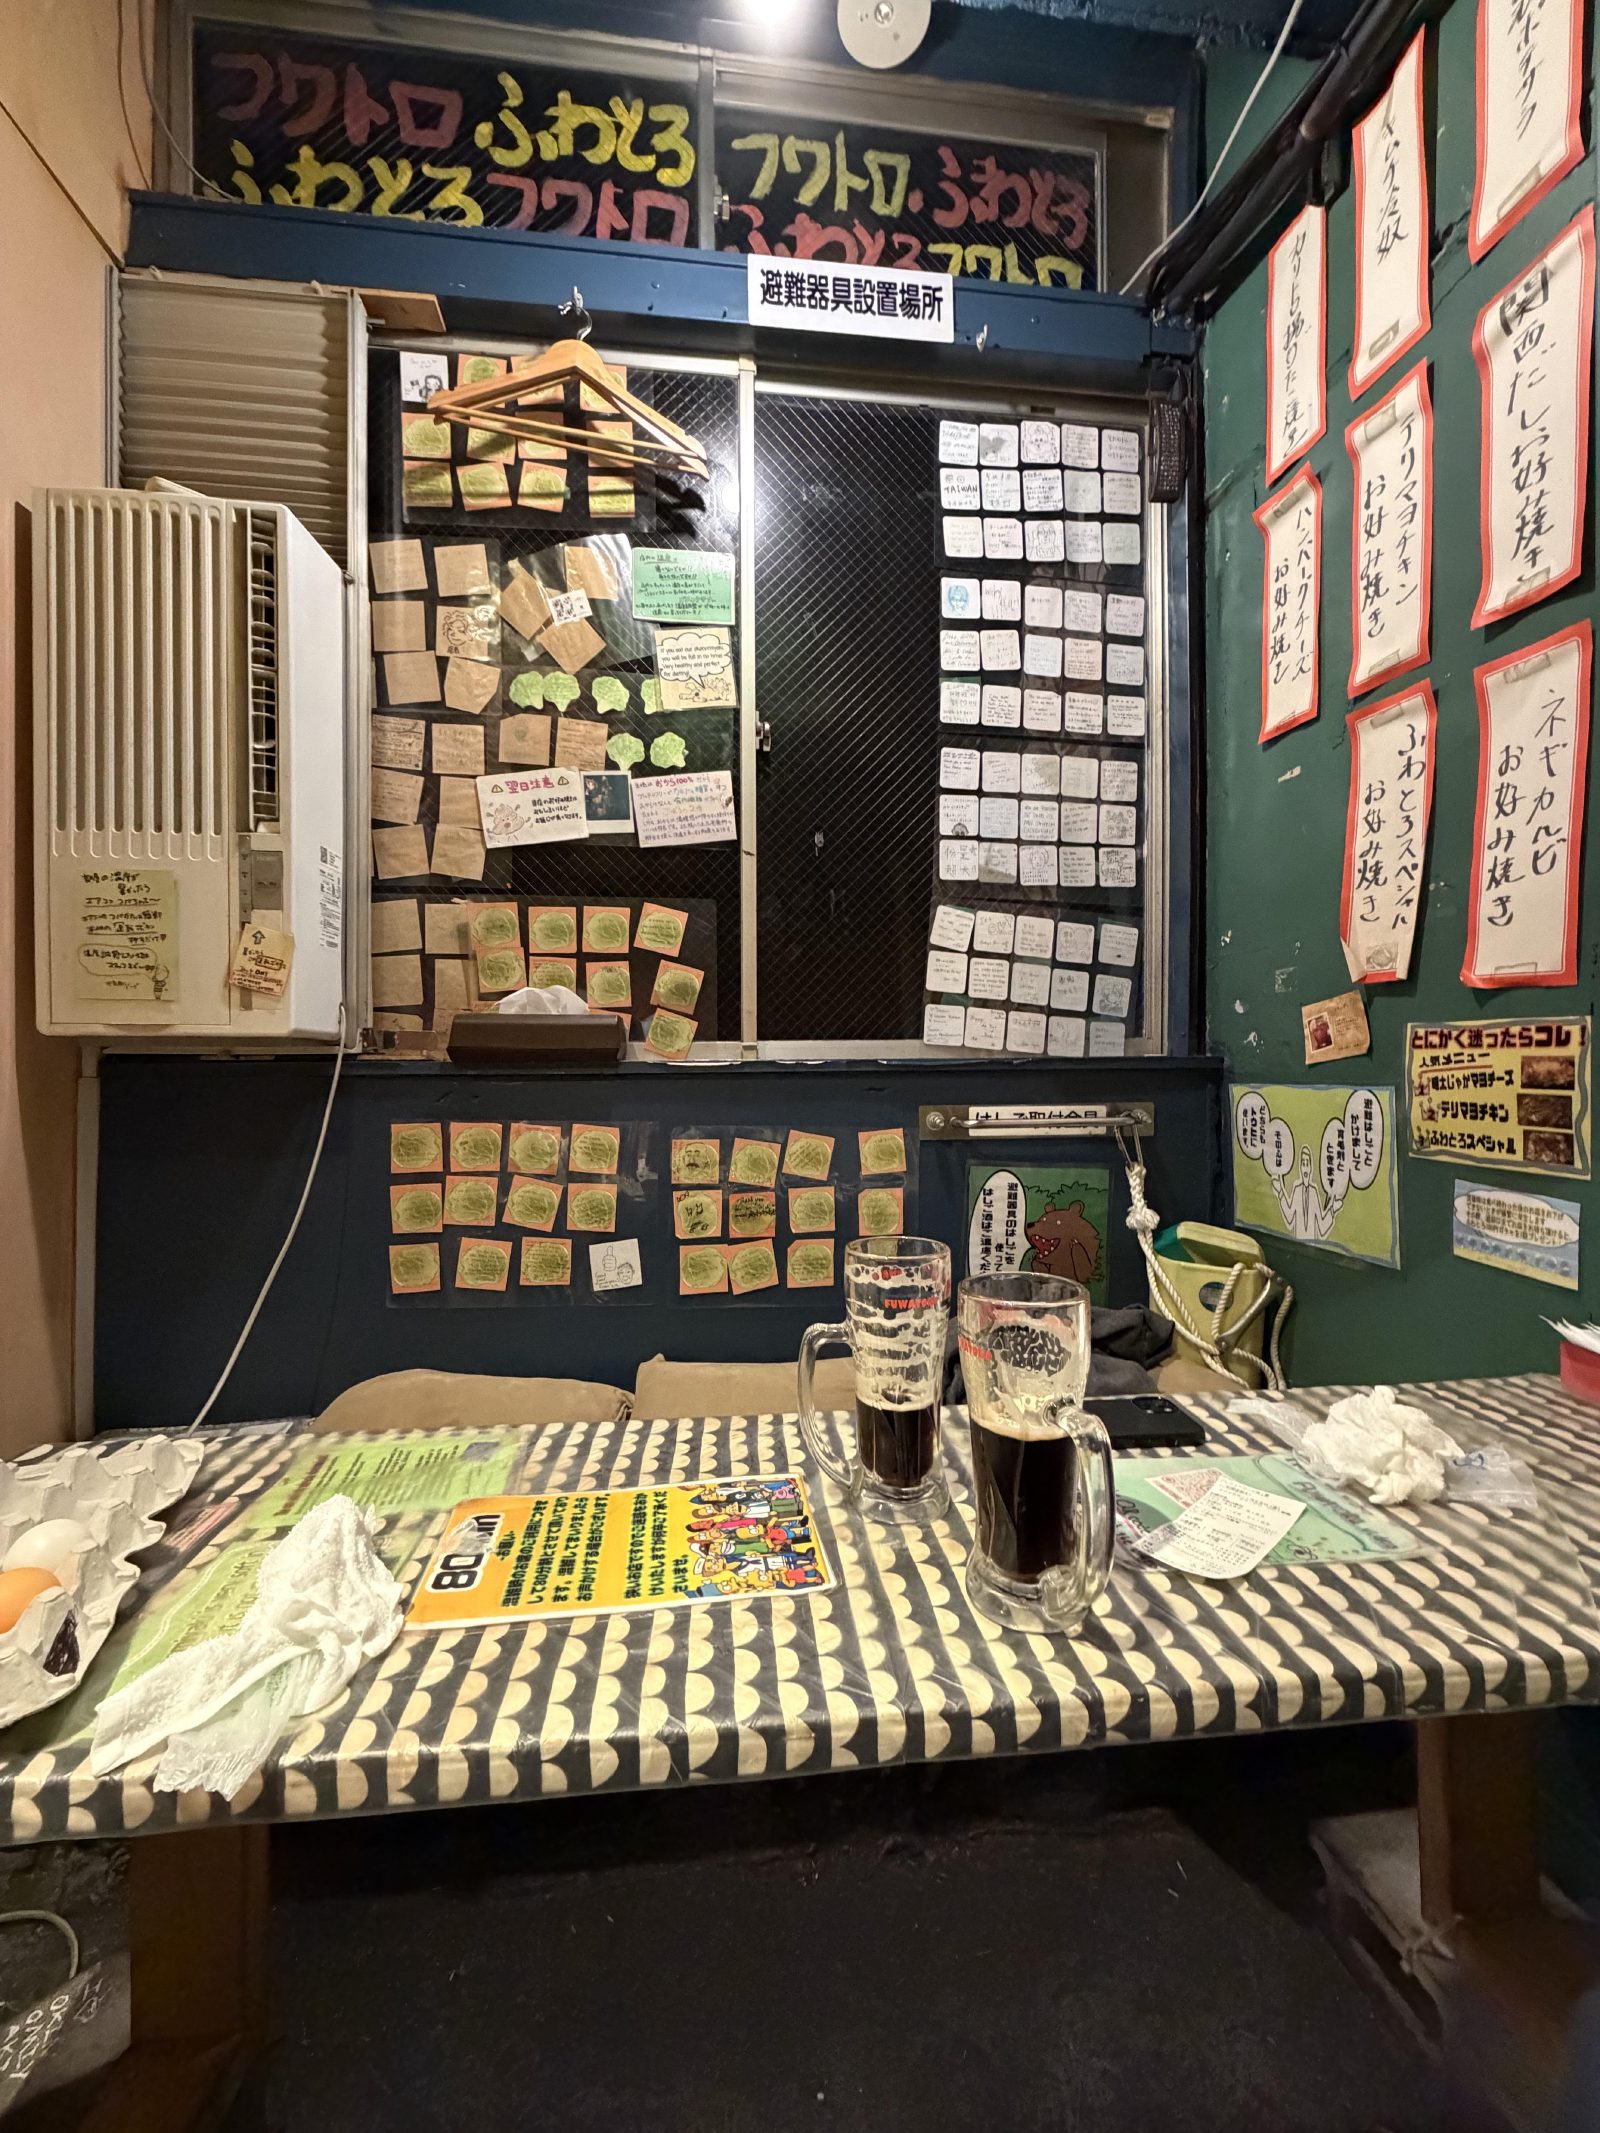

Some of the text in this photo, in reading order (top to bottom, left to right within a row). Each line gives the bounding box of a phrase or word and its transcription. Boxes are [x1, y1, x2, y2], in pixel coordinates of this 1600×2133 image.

[474, 71, 697, 187] ふわとろ
[732, 131, 910, 217] フワトロ
[760, 268, 944, 322] 避難器具設置場所
[1394, 412, 1419, 607] テリマヨチキン
[1361, 474, 1391, 639] お好み焼き
[1268, 557, 1292, 684] お好み焼き
[505, 774, 555, 794] 翌日注意
[1526, 688, 1568, 877] ネギカルビ
[1357, 780, 1387, 923] お好み焼き
[1393, 725, 1427, 930] ふわとろスペシャル
[1487, 745, 1526, 927] お好み焼き
[1412, 1025, 1588, 1049] とにかく迷ったらコレ！
[1419, 1052, 1490, 1068] 人気メニュー
[1274, 1130, 1283, 1168] その心は
[1351, 1113, 1361, 1172] かけまして
[1430, 1130, 1517, 1155] ふわとろスペシャル
[1440, 1100, 1510, 1123] テリマヨチキン
[1326, 1142, 1336, 1189] ときます
[979, 1188, 995, 1276] はしご酒はご遠慮くだ
[1005, 1182, 1019, 1266] 避難器具のはしごを
[673, 1553, 689, 1594] さいませ。
